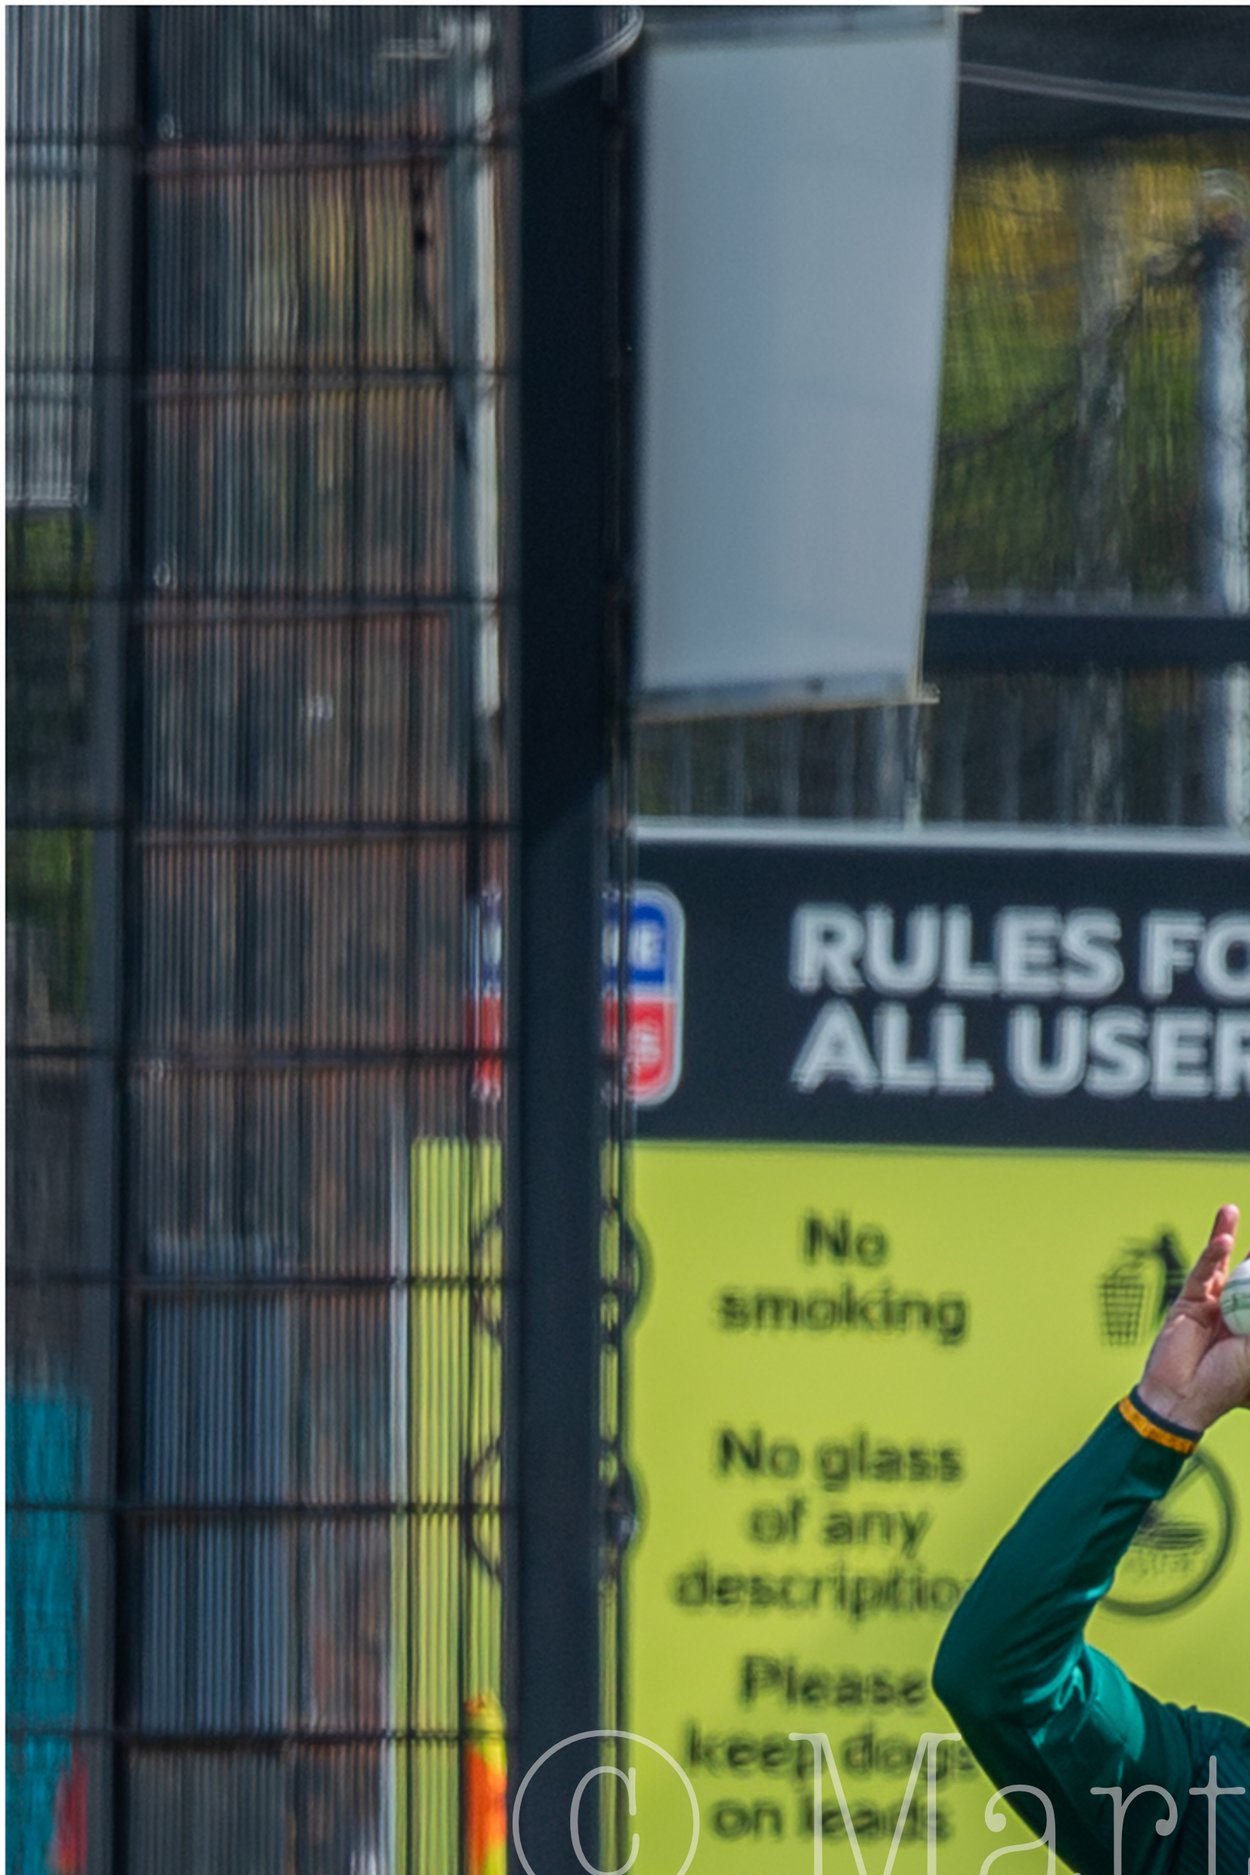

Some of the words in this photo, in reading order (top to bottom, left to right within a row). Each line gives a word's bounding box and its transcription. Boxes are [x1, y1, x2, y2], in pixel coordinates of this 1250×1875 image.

[789, 902, 1124, 998] RULES
[791, 1000, 994, 1094] ALL
[803, 1212, 889, 1267] No
[717, 1284, 969, 1347] smoking
[714, 1426, 801, 1479] No
[815, 1428, 965, 1492] glass
[748, 1496, 806, 1546] of
[823, 1508, 930, 1558] any
[672, 1559, 976, 1624] descriptio
[740, 1654, 928, 1706] Please
[684, 1720, 822, 1786] keep
[842, 1724, 979, 1790] dogs
[711, 1800, 785, 1841] on
[801, 1797, 952, 1842] leads
